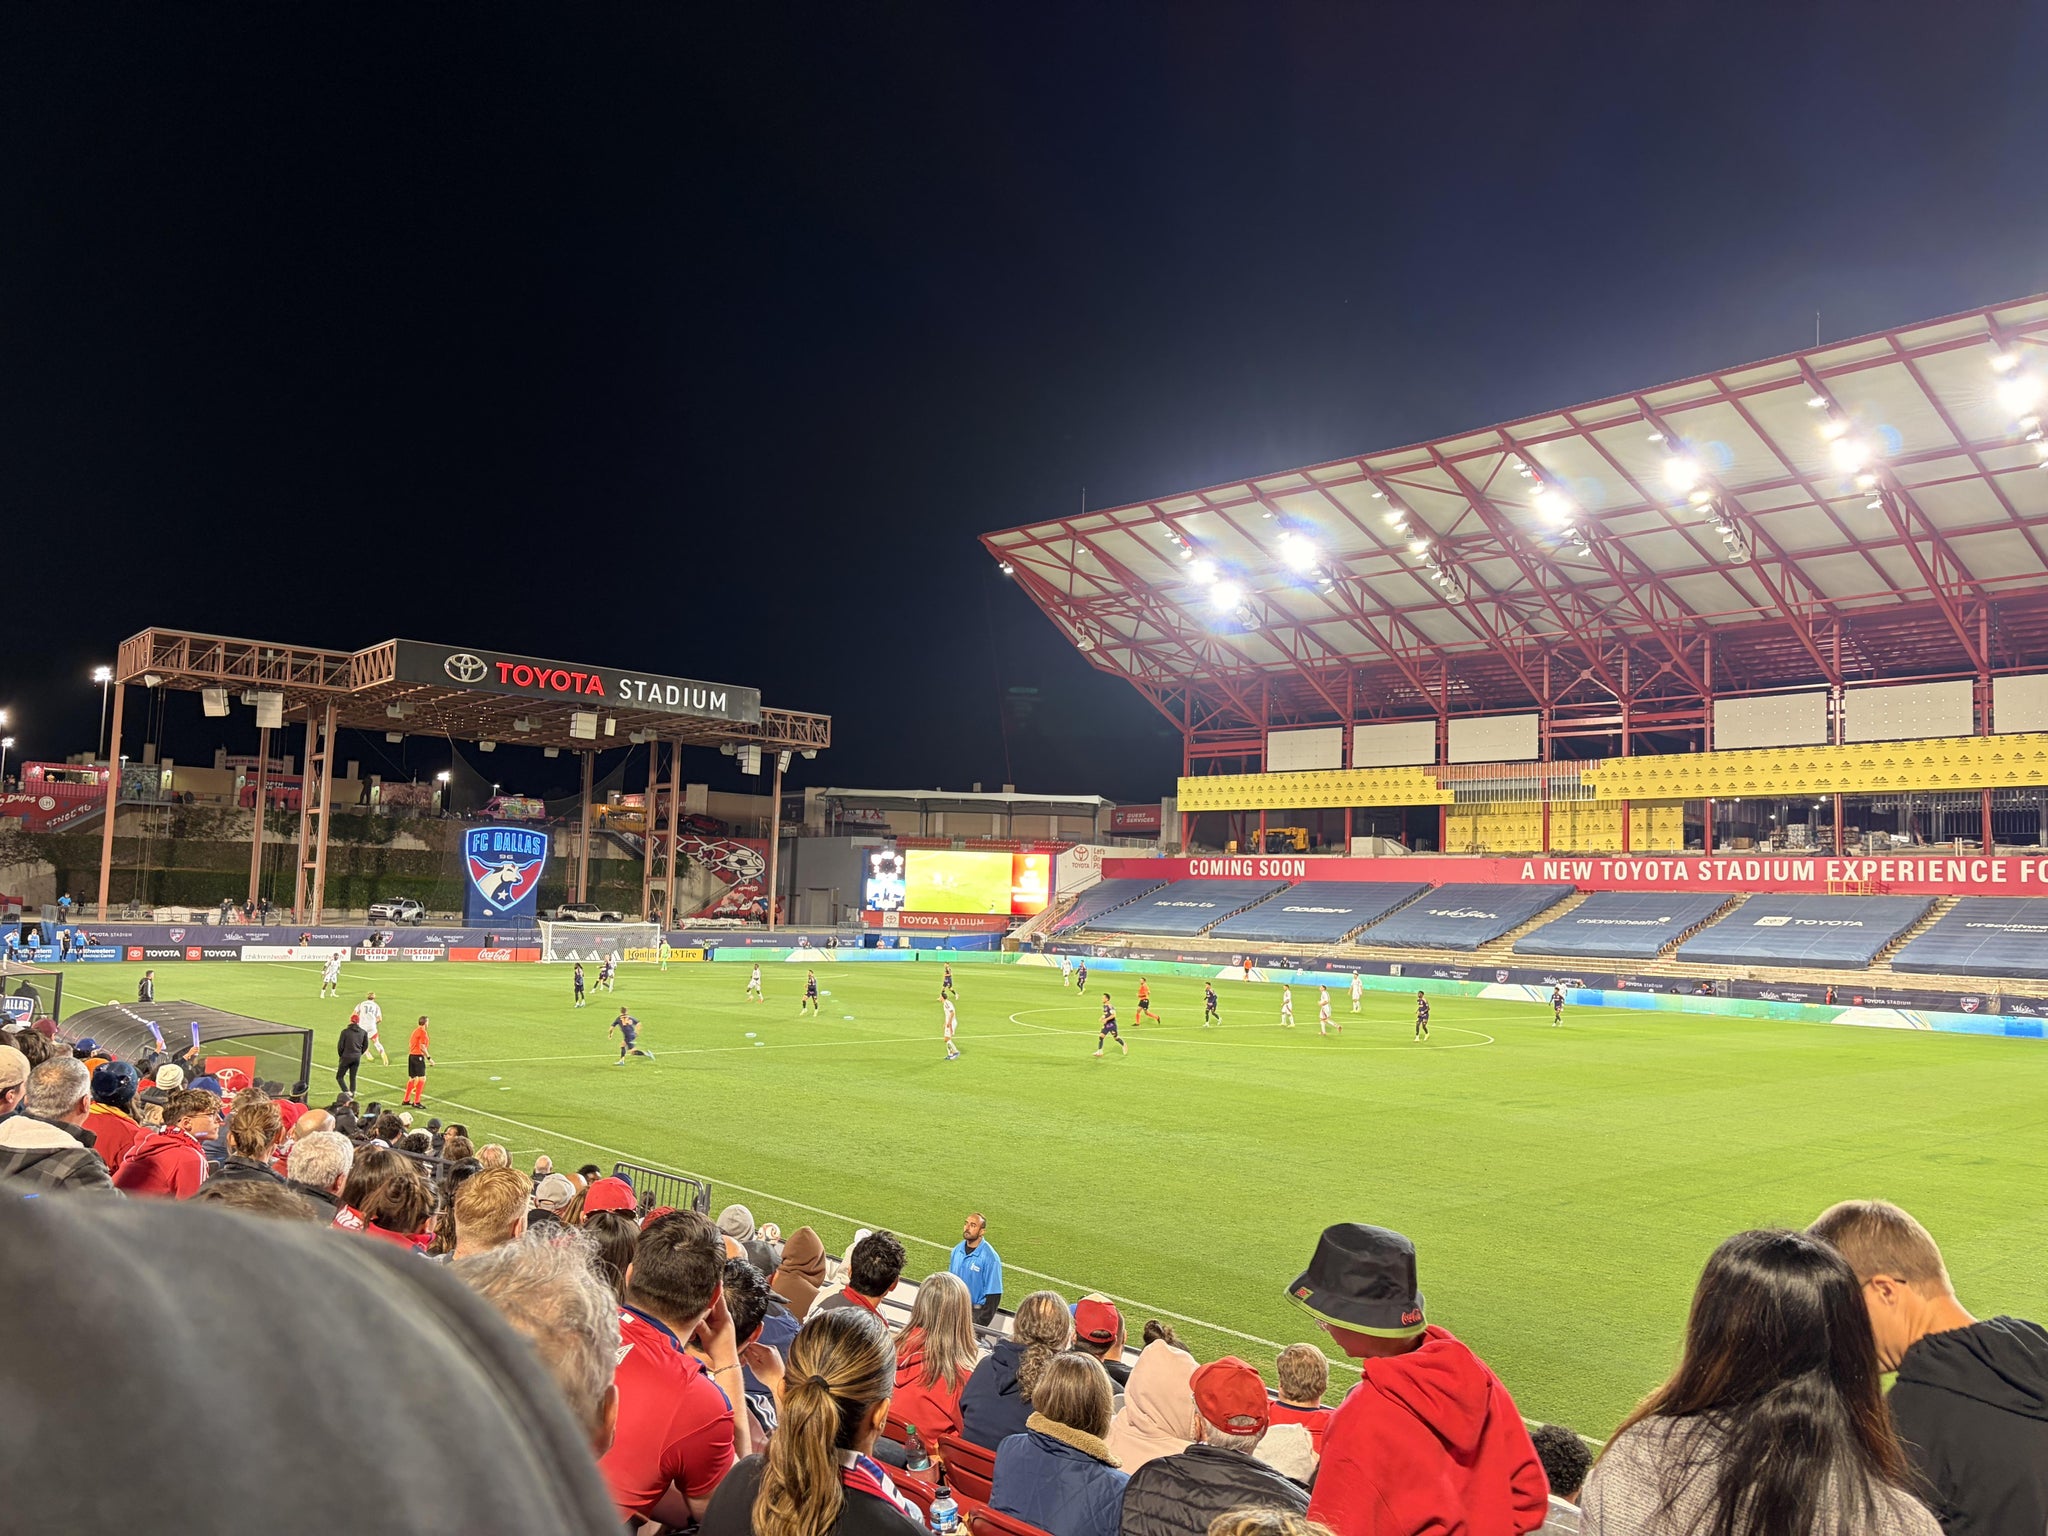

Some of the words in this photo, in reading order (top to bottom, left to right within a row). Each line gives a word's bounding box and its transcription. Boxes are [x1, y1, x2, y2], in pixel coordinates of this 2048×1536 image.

[496, 662, 605, 696] TOYOTA
[619, 679, 726, 712] STADIUM
[473, 833, 488, 852] FC
[494, 832, 540, 855] DALLAS
[1189, 860, 1252, 876] COMING
[1259, 860, 1305, 877] SOON
[1521, 862, 1535, 880] A
[1543, 862, 1593, 880] NEW
[1600, 861, 1689, 881] TOYOTA
[1698, 860, 1815, 881] STADIUM
[1827, 860, 2007, 883] EXPERIENCE
[902, 916, 940, 925] TOYOTA
[943, 917, 985, 926] STADIUM
[1795, 919, 1863, 927] TOYOTA
[146, 950, 181, 958] TOYOTA
[203, 950, 237, 958] TOYOTA
[679, 950, 697, 958] Tire
[3, 999, 29, 1010] ALLAS
